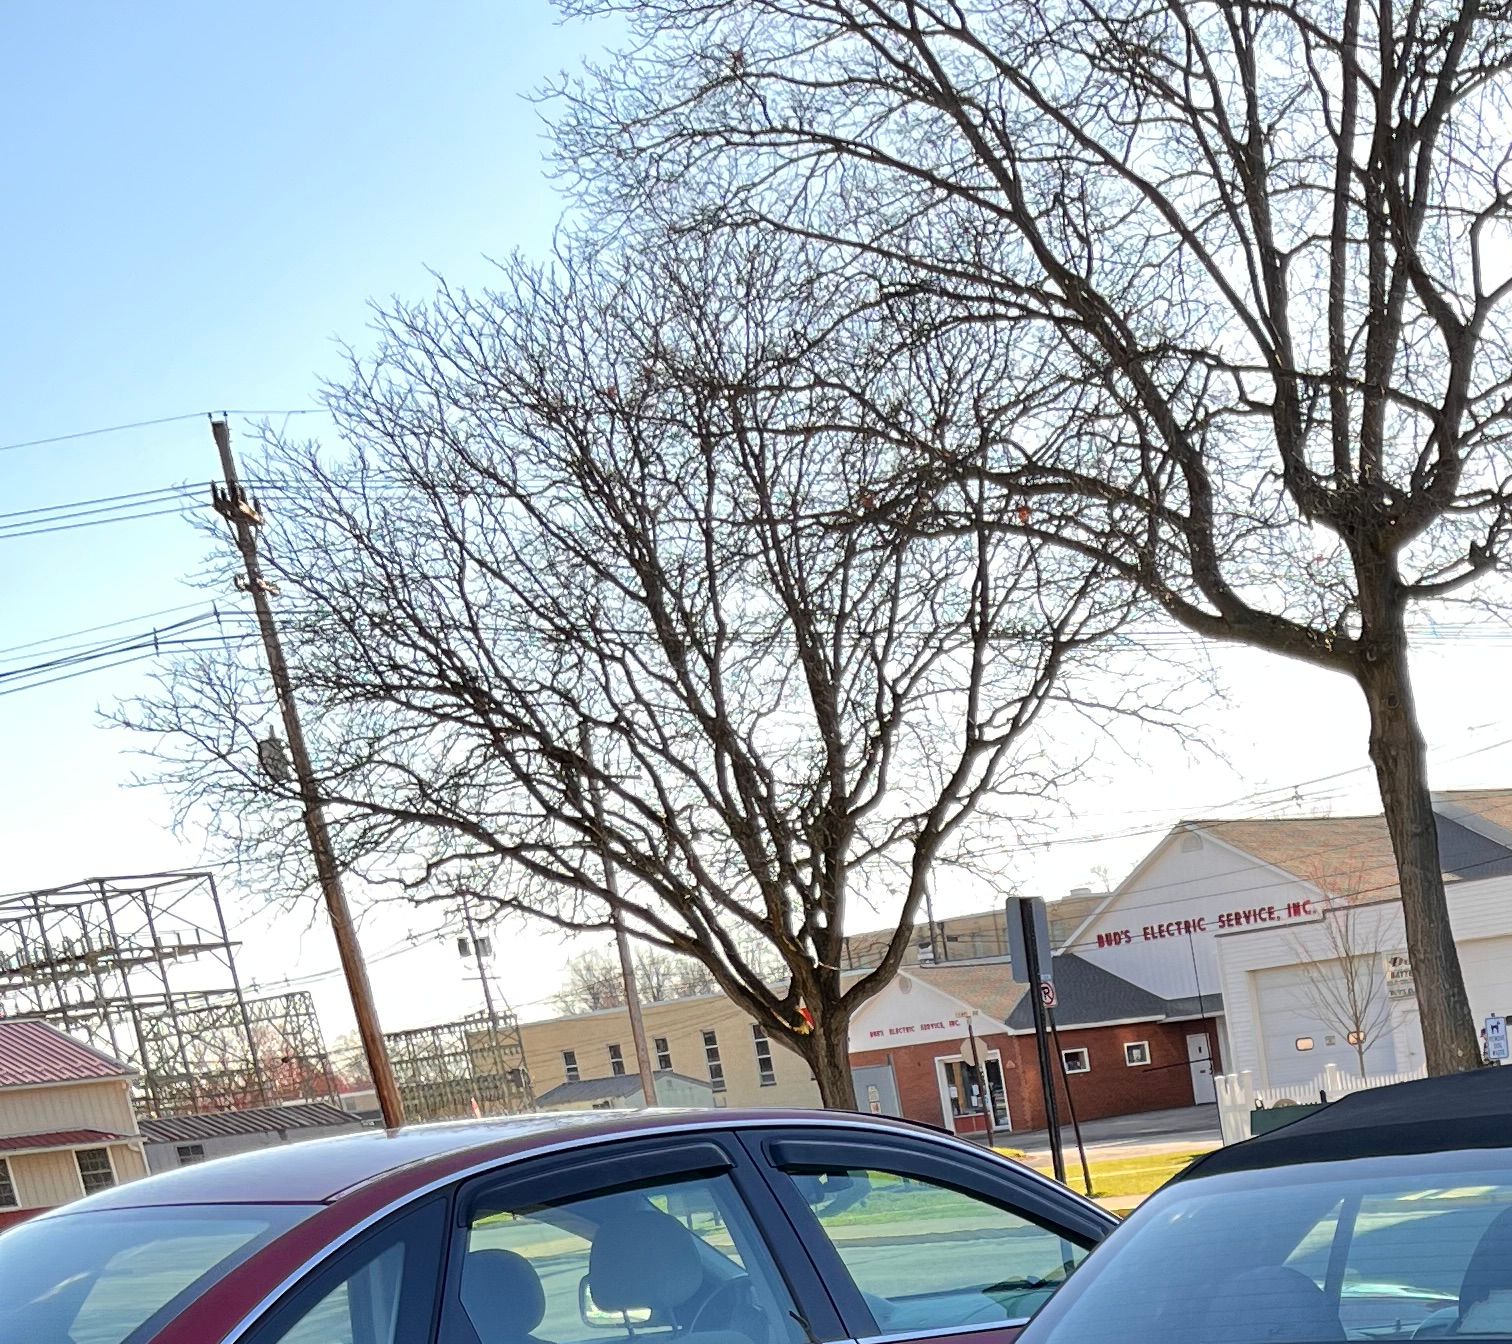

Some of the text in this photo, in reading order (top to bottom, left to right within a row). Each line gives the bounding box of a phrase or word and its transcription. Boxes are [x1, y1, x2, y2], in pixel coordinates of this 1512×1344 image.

[1096, 900, 1317, 949] BUD'S ELECTRIC SERVICE, INC.
